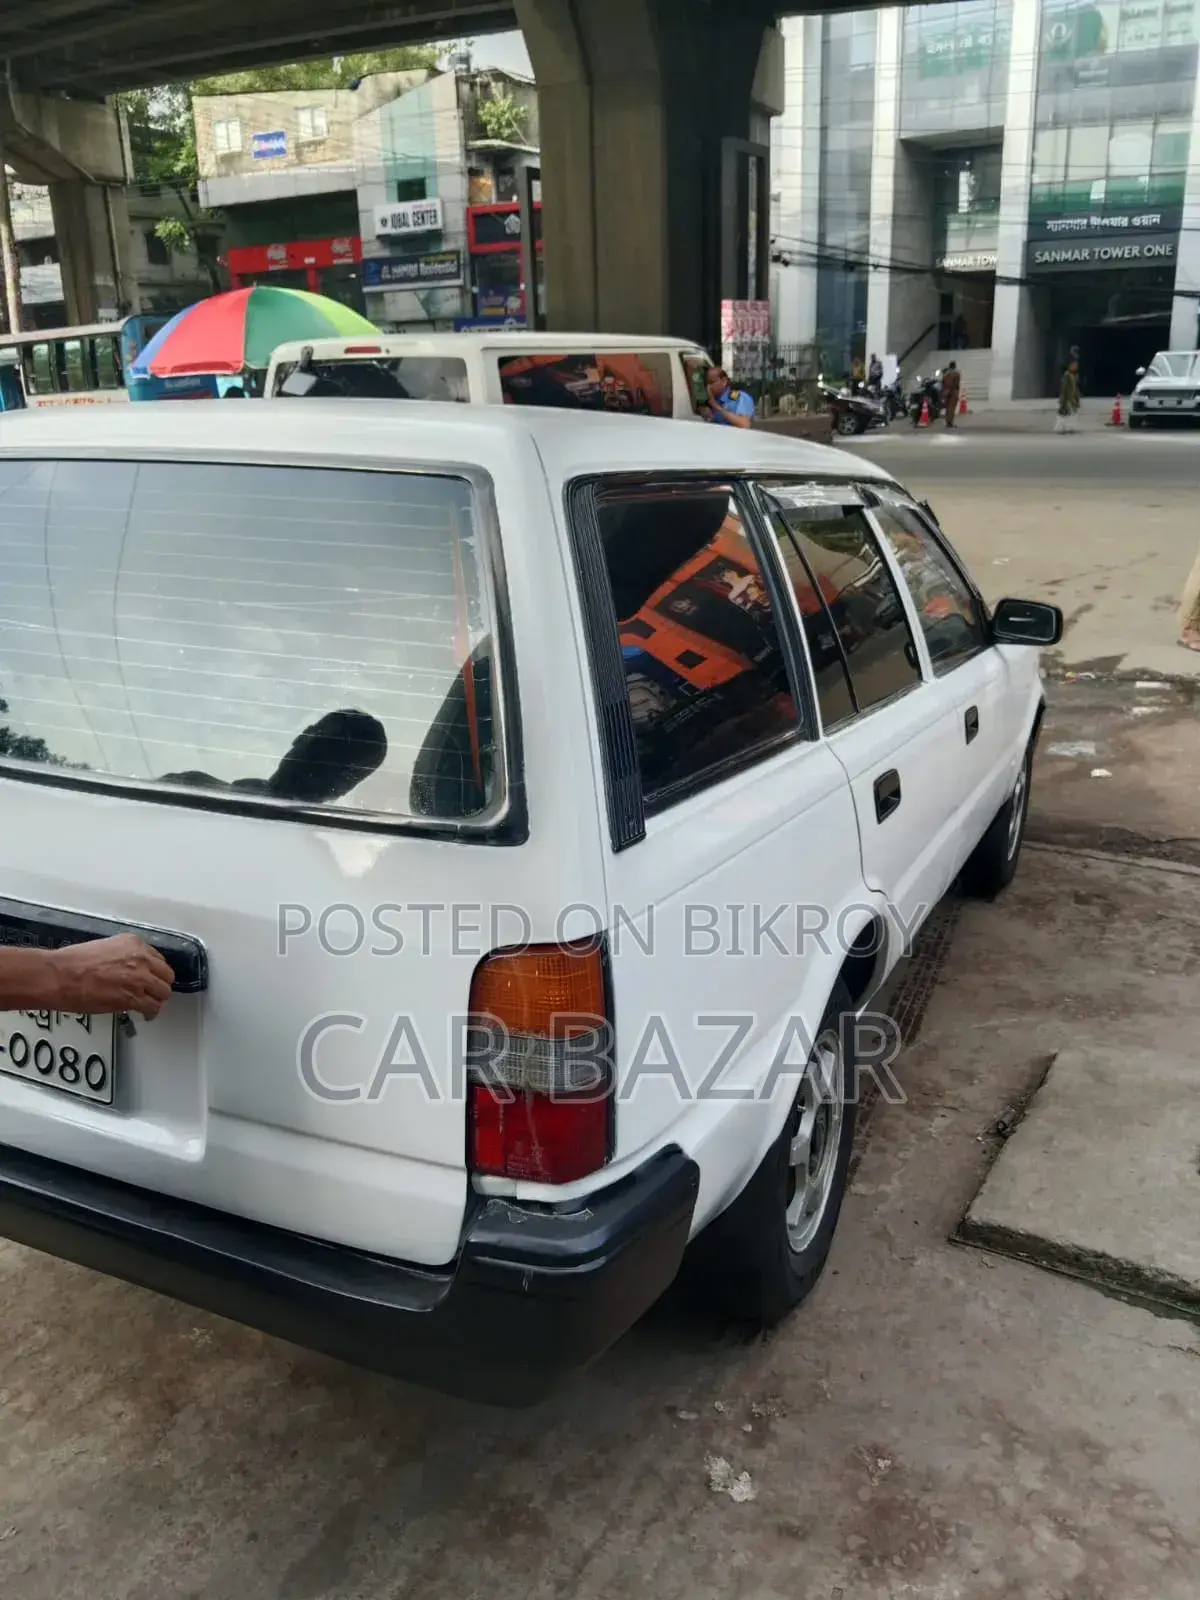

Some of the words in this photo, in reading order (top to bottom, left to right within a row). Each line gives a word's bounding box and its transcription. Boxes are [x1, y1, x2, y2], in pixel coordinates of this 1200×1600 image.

[412, 208, 438, 226] CENTER
[1034, 249, 1090, 264] SANMAR
[1094, 246, 1141, 260] TOWER
[1143, 243, 1173, 257] ONE
